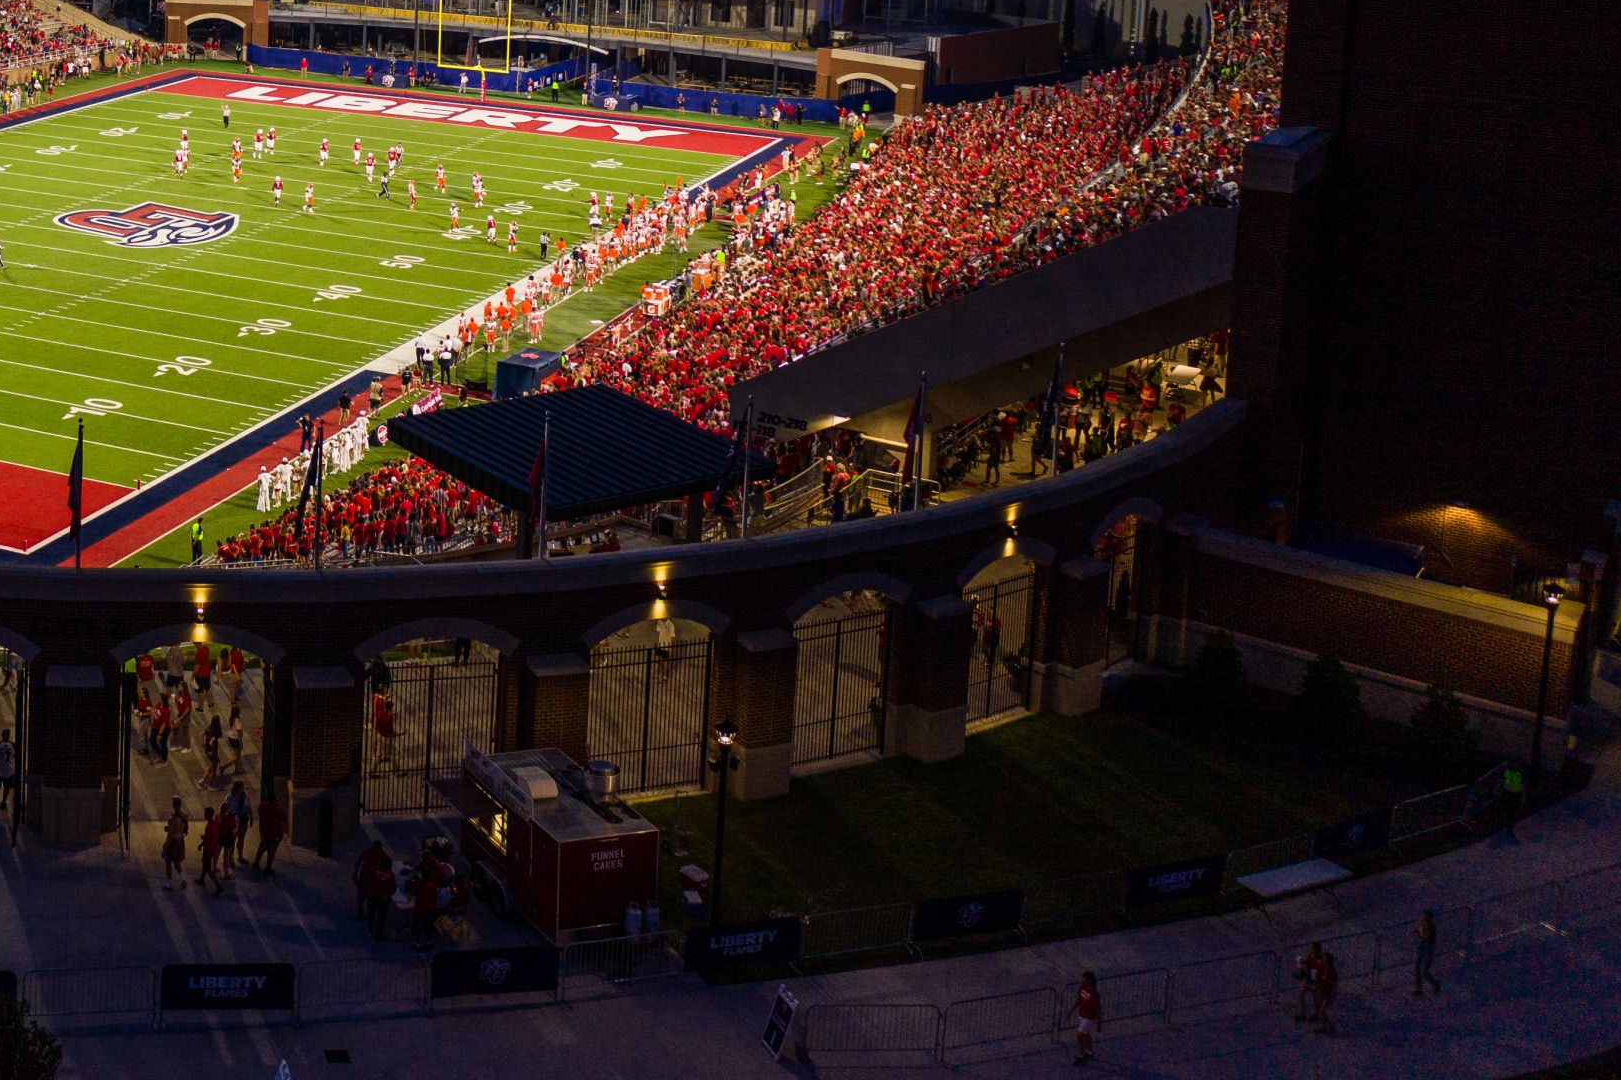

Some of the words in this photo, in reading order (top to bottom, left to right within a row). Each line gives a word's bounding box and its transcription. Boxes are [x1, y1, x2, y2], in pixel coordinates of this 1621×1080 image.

[227, 86, 690, 141] LIBERTY
[380, 254, 425, 269] 50
[316, 284, 362, 300] 40
[240, 318, 291, 336] 30
[157, 355, 212, 376] 20
[69, 398, 123, 416] 10
[758, 412, 808, 431] 210-218
[591, 849, 626, 862] FUNNEL
[593, 859, 624, 871] CAKES
[1147, 867, 1206, 889] LIBERTY
[709, 928, 779, 950] LIBERTY
[723, 943, 762, 956] FLAMES
[187, 975, 268, 990] LIBERTY
[203, 988, 250, 999] FLAMES
